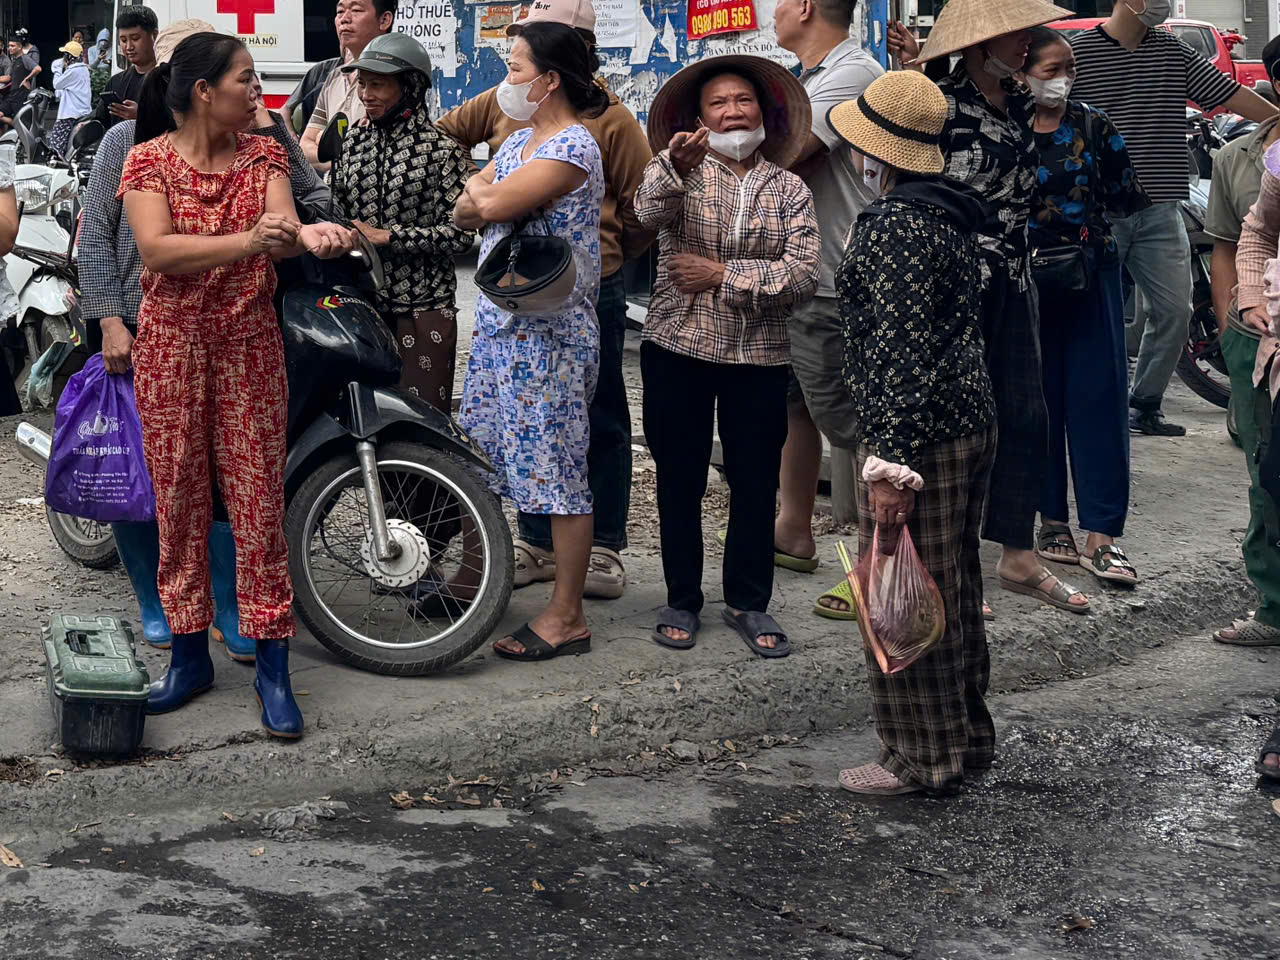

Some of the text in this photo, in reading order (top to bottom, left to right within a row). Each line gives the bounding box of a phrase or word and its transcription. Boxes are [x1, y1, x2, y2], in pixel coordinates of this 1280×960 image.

[397, 1, 452, 20] HO THUÊ
[732, 6, 751, 27] 563
[249, 36, 260, 44] HÀ
[263, 35, 277, 46] NỘI
